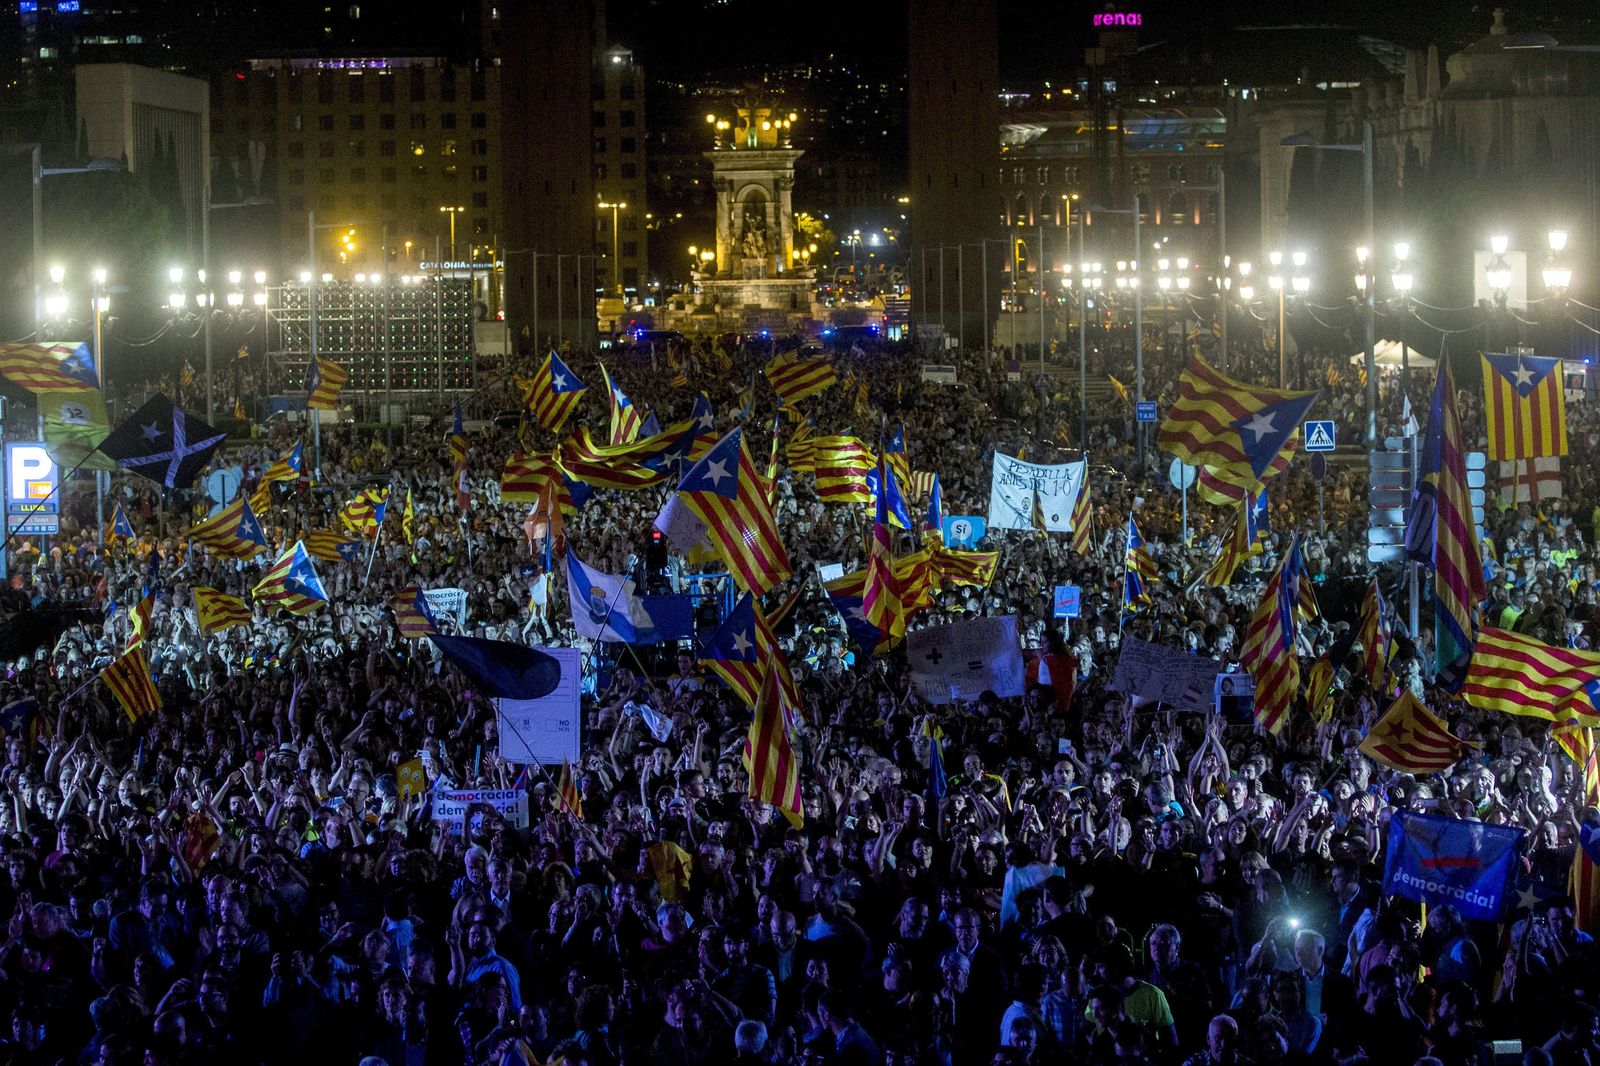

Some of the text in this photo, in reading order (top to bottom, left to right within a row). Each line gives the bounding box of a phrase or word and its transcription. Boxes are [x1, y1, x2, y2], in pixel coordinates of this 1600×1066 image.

[1093, 13, 1142, 26] arenas
[420, 261, 466, 269] CATALONIA
[12, 447, 52, 499] P
[1008, 460, 1072, 481] PESADILLA
[956, 524, 968, 535] Sí
[1393, 866, 1496, 909] democràcia!
